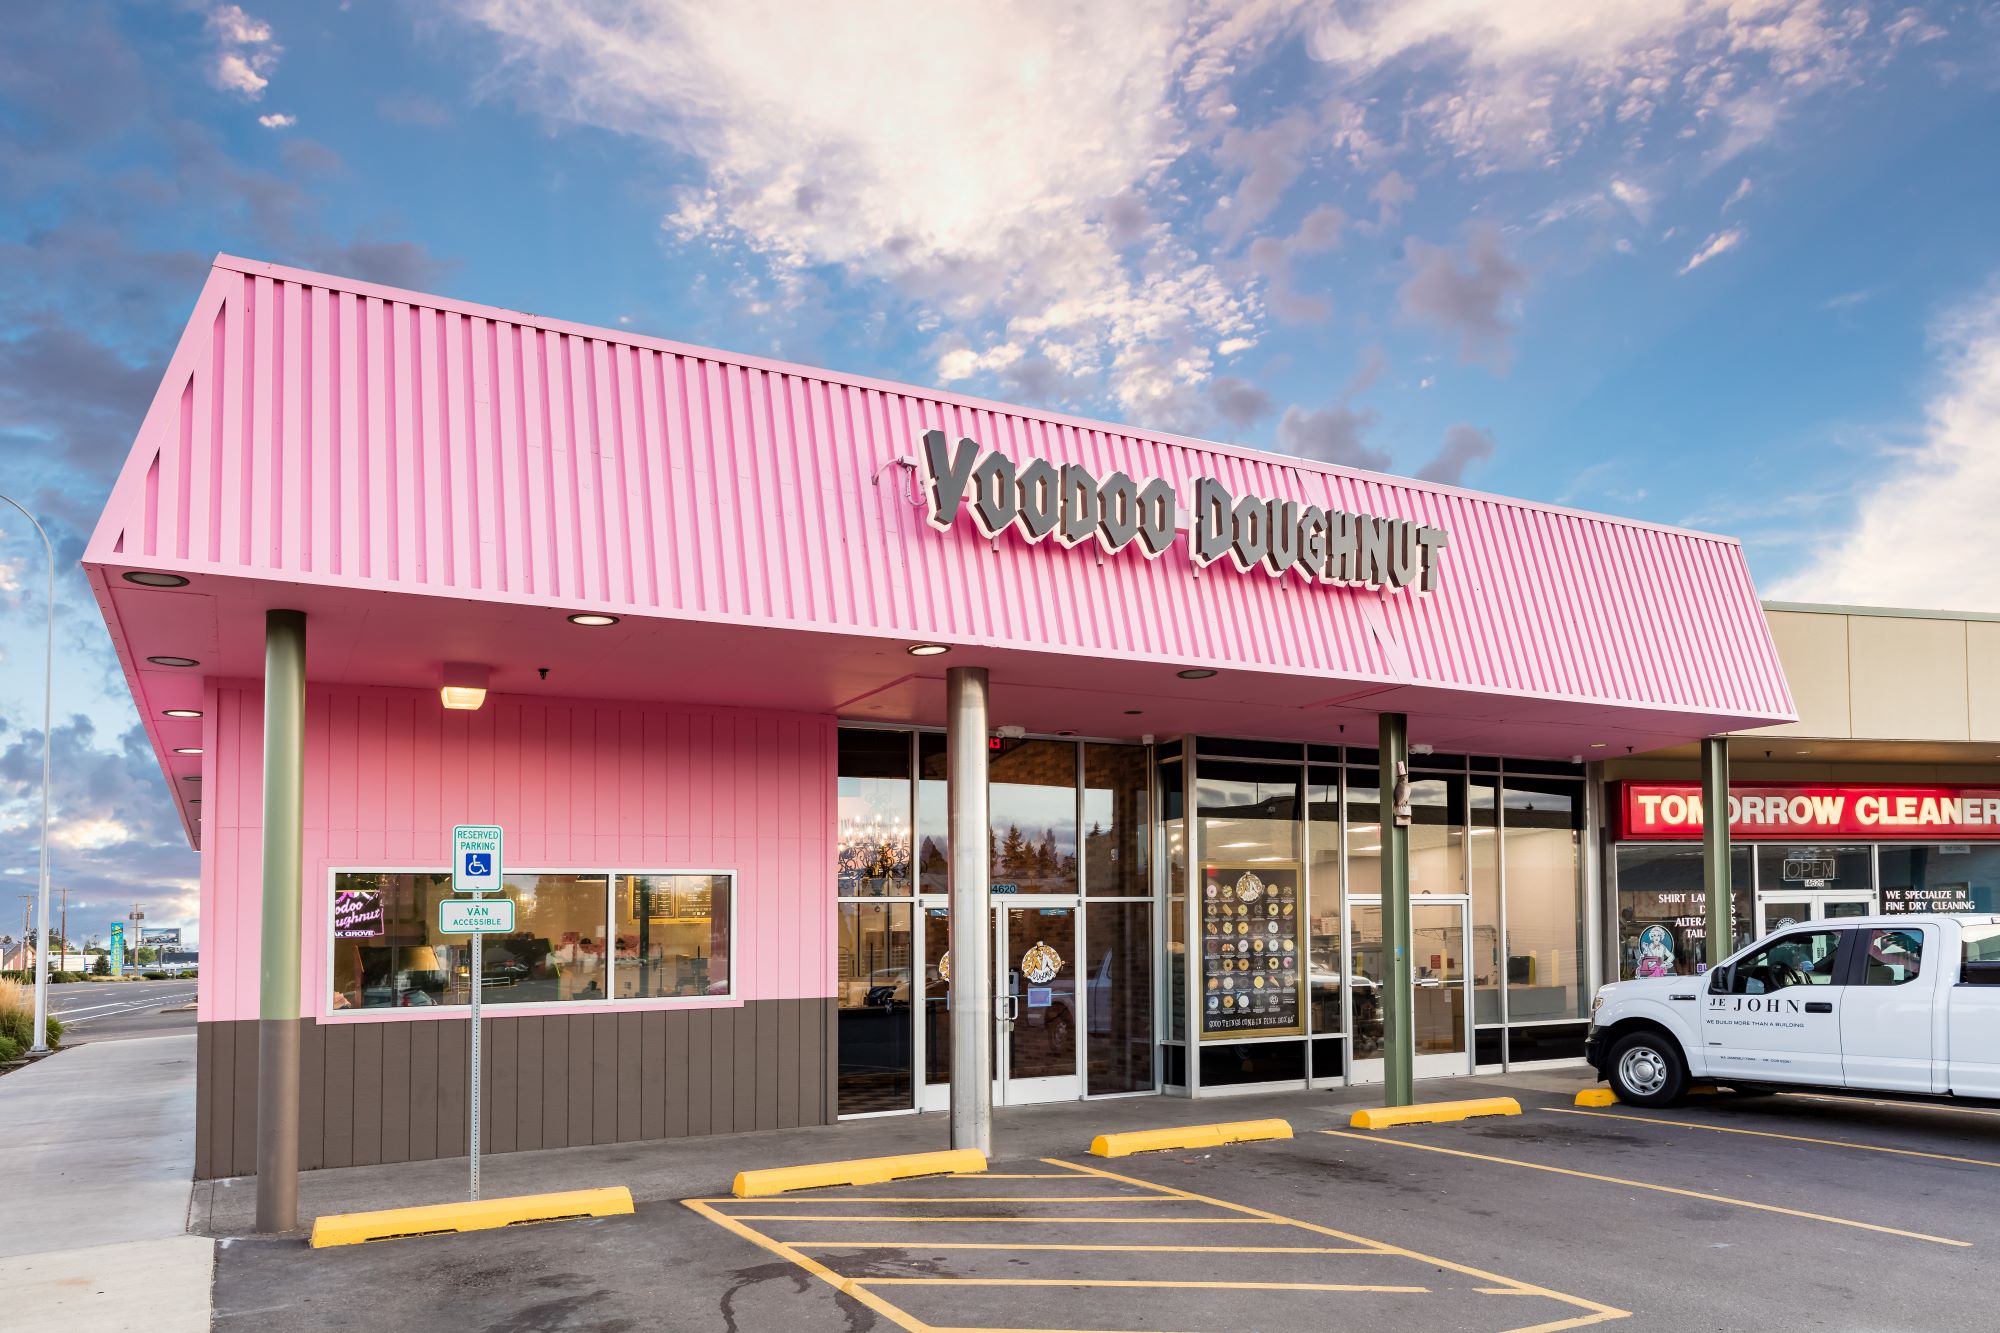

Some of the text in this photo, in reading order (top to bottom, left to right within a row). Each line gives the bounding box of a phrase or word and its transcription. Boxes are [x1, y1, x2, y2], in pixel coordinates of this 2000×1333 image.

[919, 429, 1449, 597] VOODOO DOUGHNUT
[457, 830, 499, 840] RESERVED
[460, 842, 495, 851] PARKING
[1786, 860, 1833, 879] OPEN
[1658, 893, 1687, 903] SHIRT
[1885, 890, 1966, 900] WE SPECIALIZE IN
[1885, 900, 1976, 911] FINE DRY CLEANING
[467, 907, 489, 916] VAN
[453, 918, 501, 926] ACCESSIBLE
[1675, 917, 1737, 927] ALTERAS
[1686, 929, 1737, 938] TAILG
[1709, 998, 1800, 1014] JE JOHN
